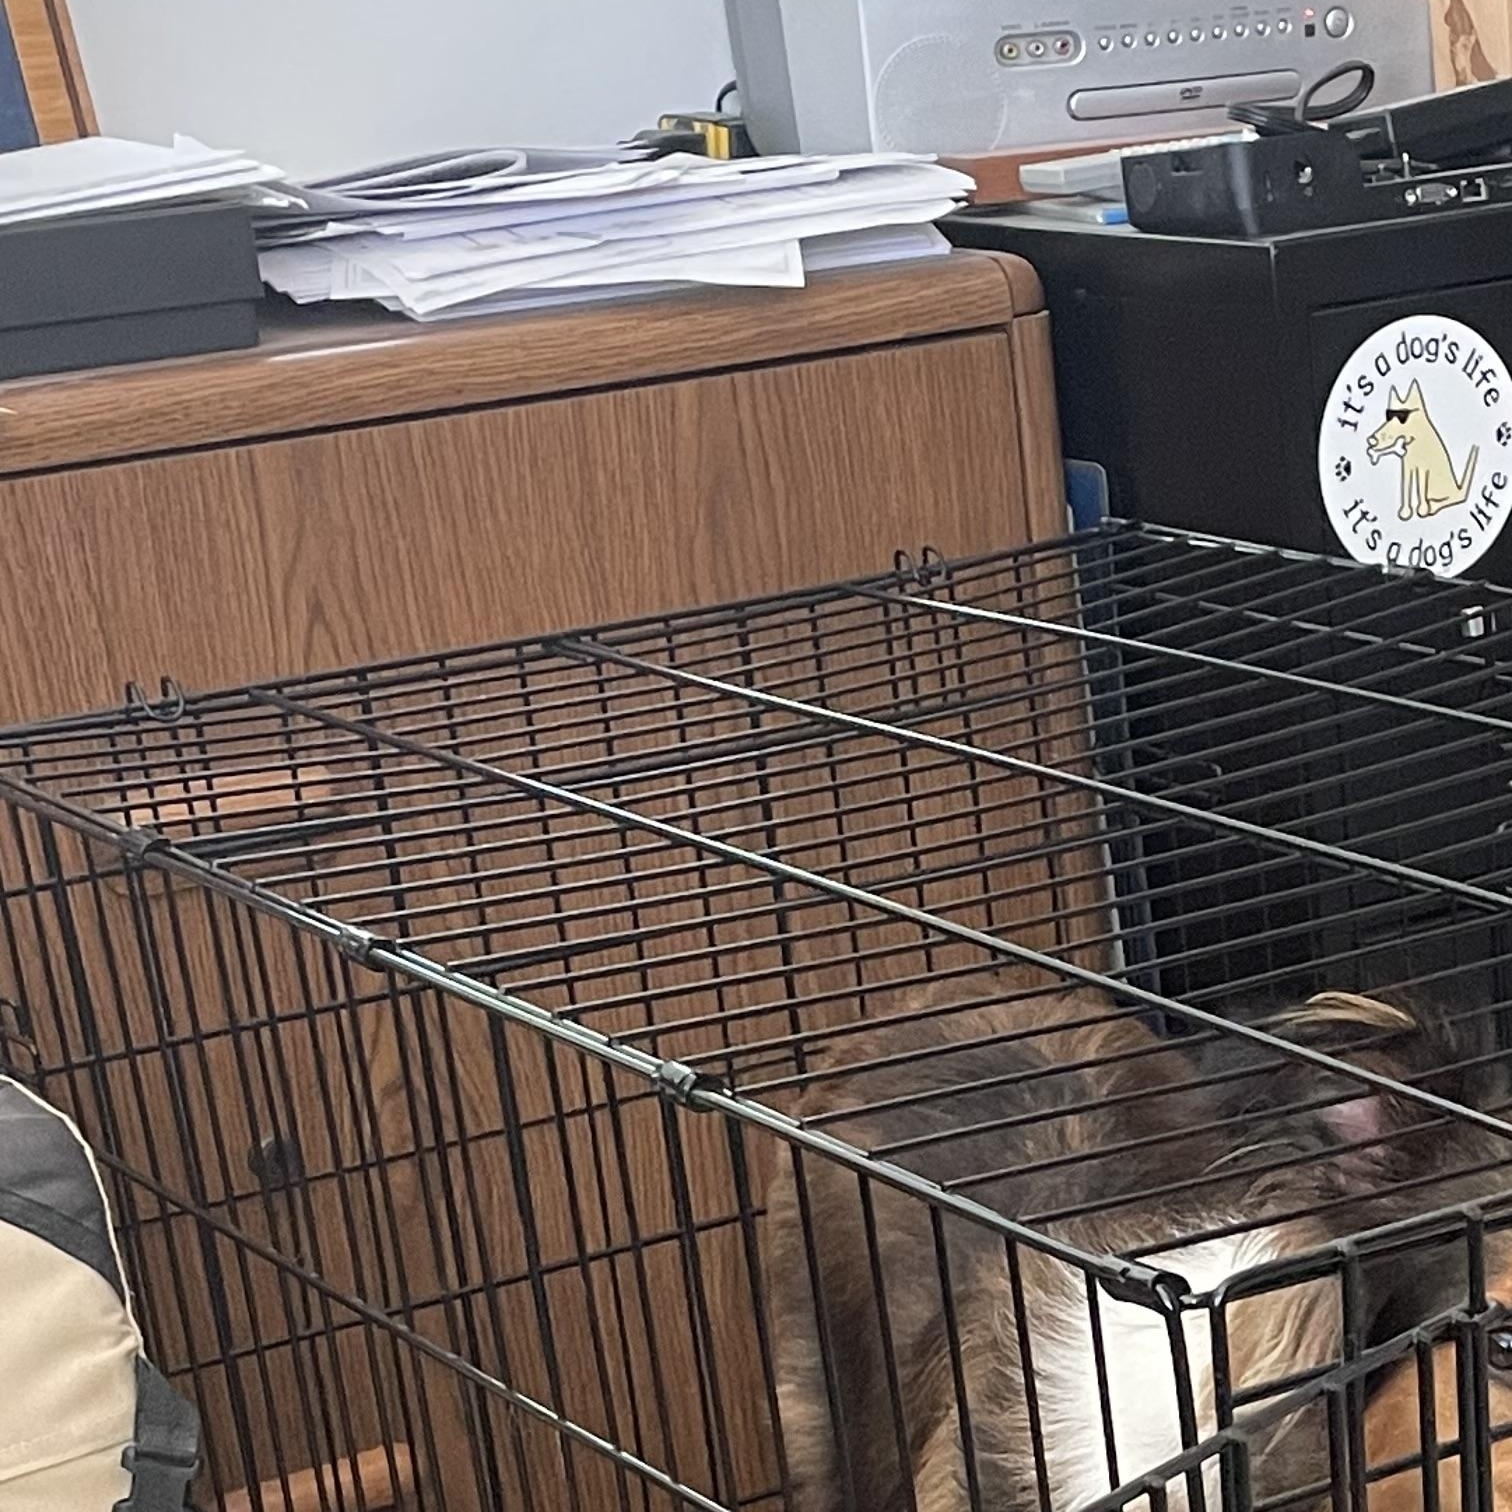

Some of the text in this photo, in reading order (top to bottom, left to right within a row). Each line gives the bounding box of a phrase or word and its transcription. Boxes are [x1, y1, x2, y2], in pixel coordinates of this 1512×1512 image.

[1336, 330, 1501, 432] it's a dog's life
[1342, 497, 1384, 552] it's
[1408, 527, 1473, 568] dog's
[1469, 471, 1509, 532] life
